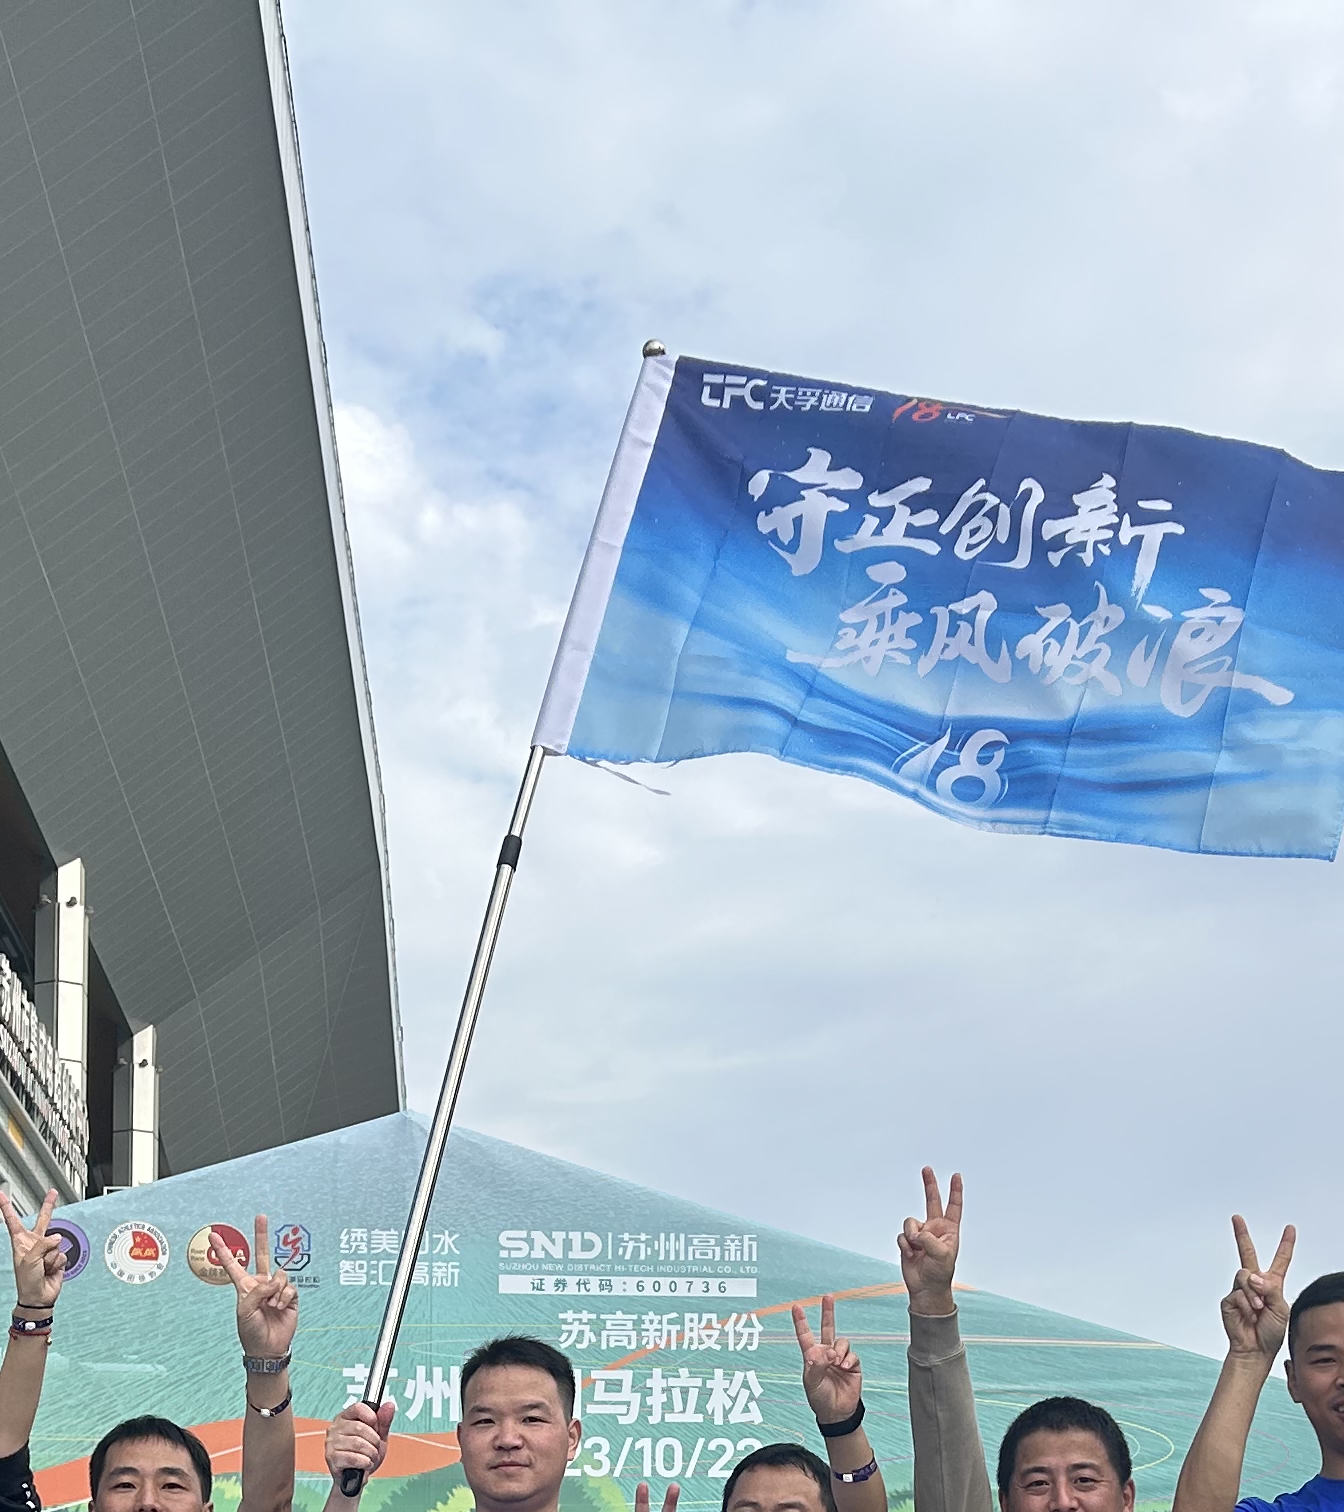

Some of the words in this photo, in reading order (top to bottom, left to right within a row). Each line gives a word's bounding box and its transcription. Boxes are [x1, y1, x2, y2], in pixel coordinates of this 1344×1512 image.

[769, 384, 874, 413] 天孚通信
[748, 446, 1186, 598] 守正创新
[786, 561, 1295, 718] 乘风破浪
[894, 727, 1013, 808] 18
[339, 1228, 460, 1255] 绣美水
[498, 1230, 603, 1259] SND
[617, 1232, 758, 1262] 苏州高新
[498, 1262, 540, 1271] SUZHOU
[541, 1263, 564, 1271] NEW
[567, 1263, 612, 1273] DISTRICT
[656, 1264, 714, 1274] INDUSTRIAL
[558, 1309, 764, 1351] 苏高新股份
